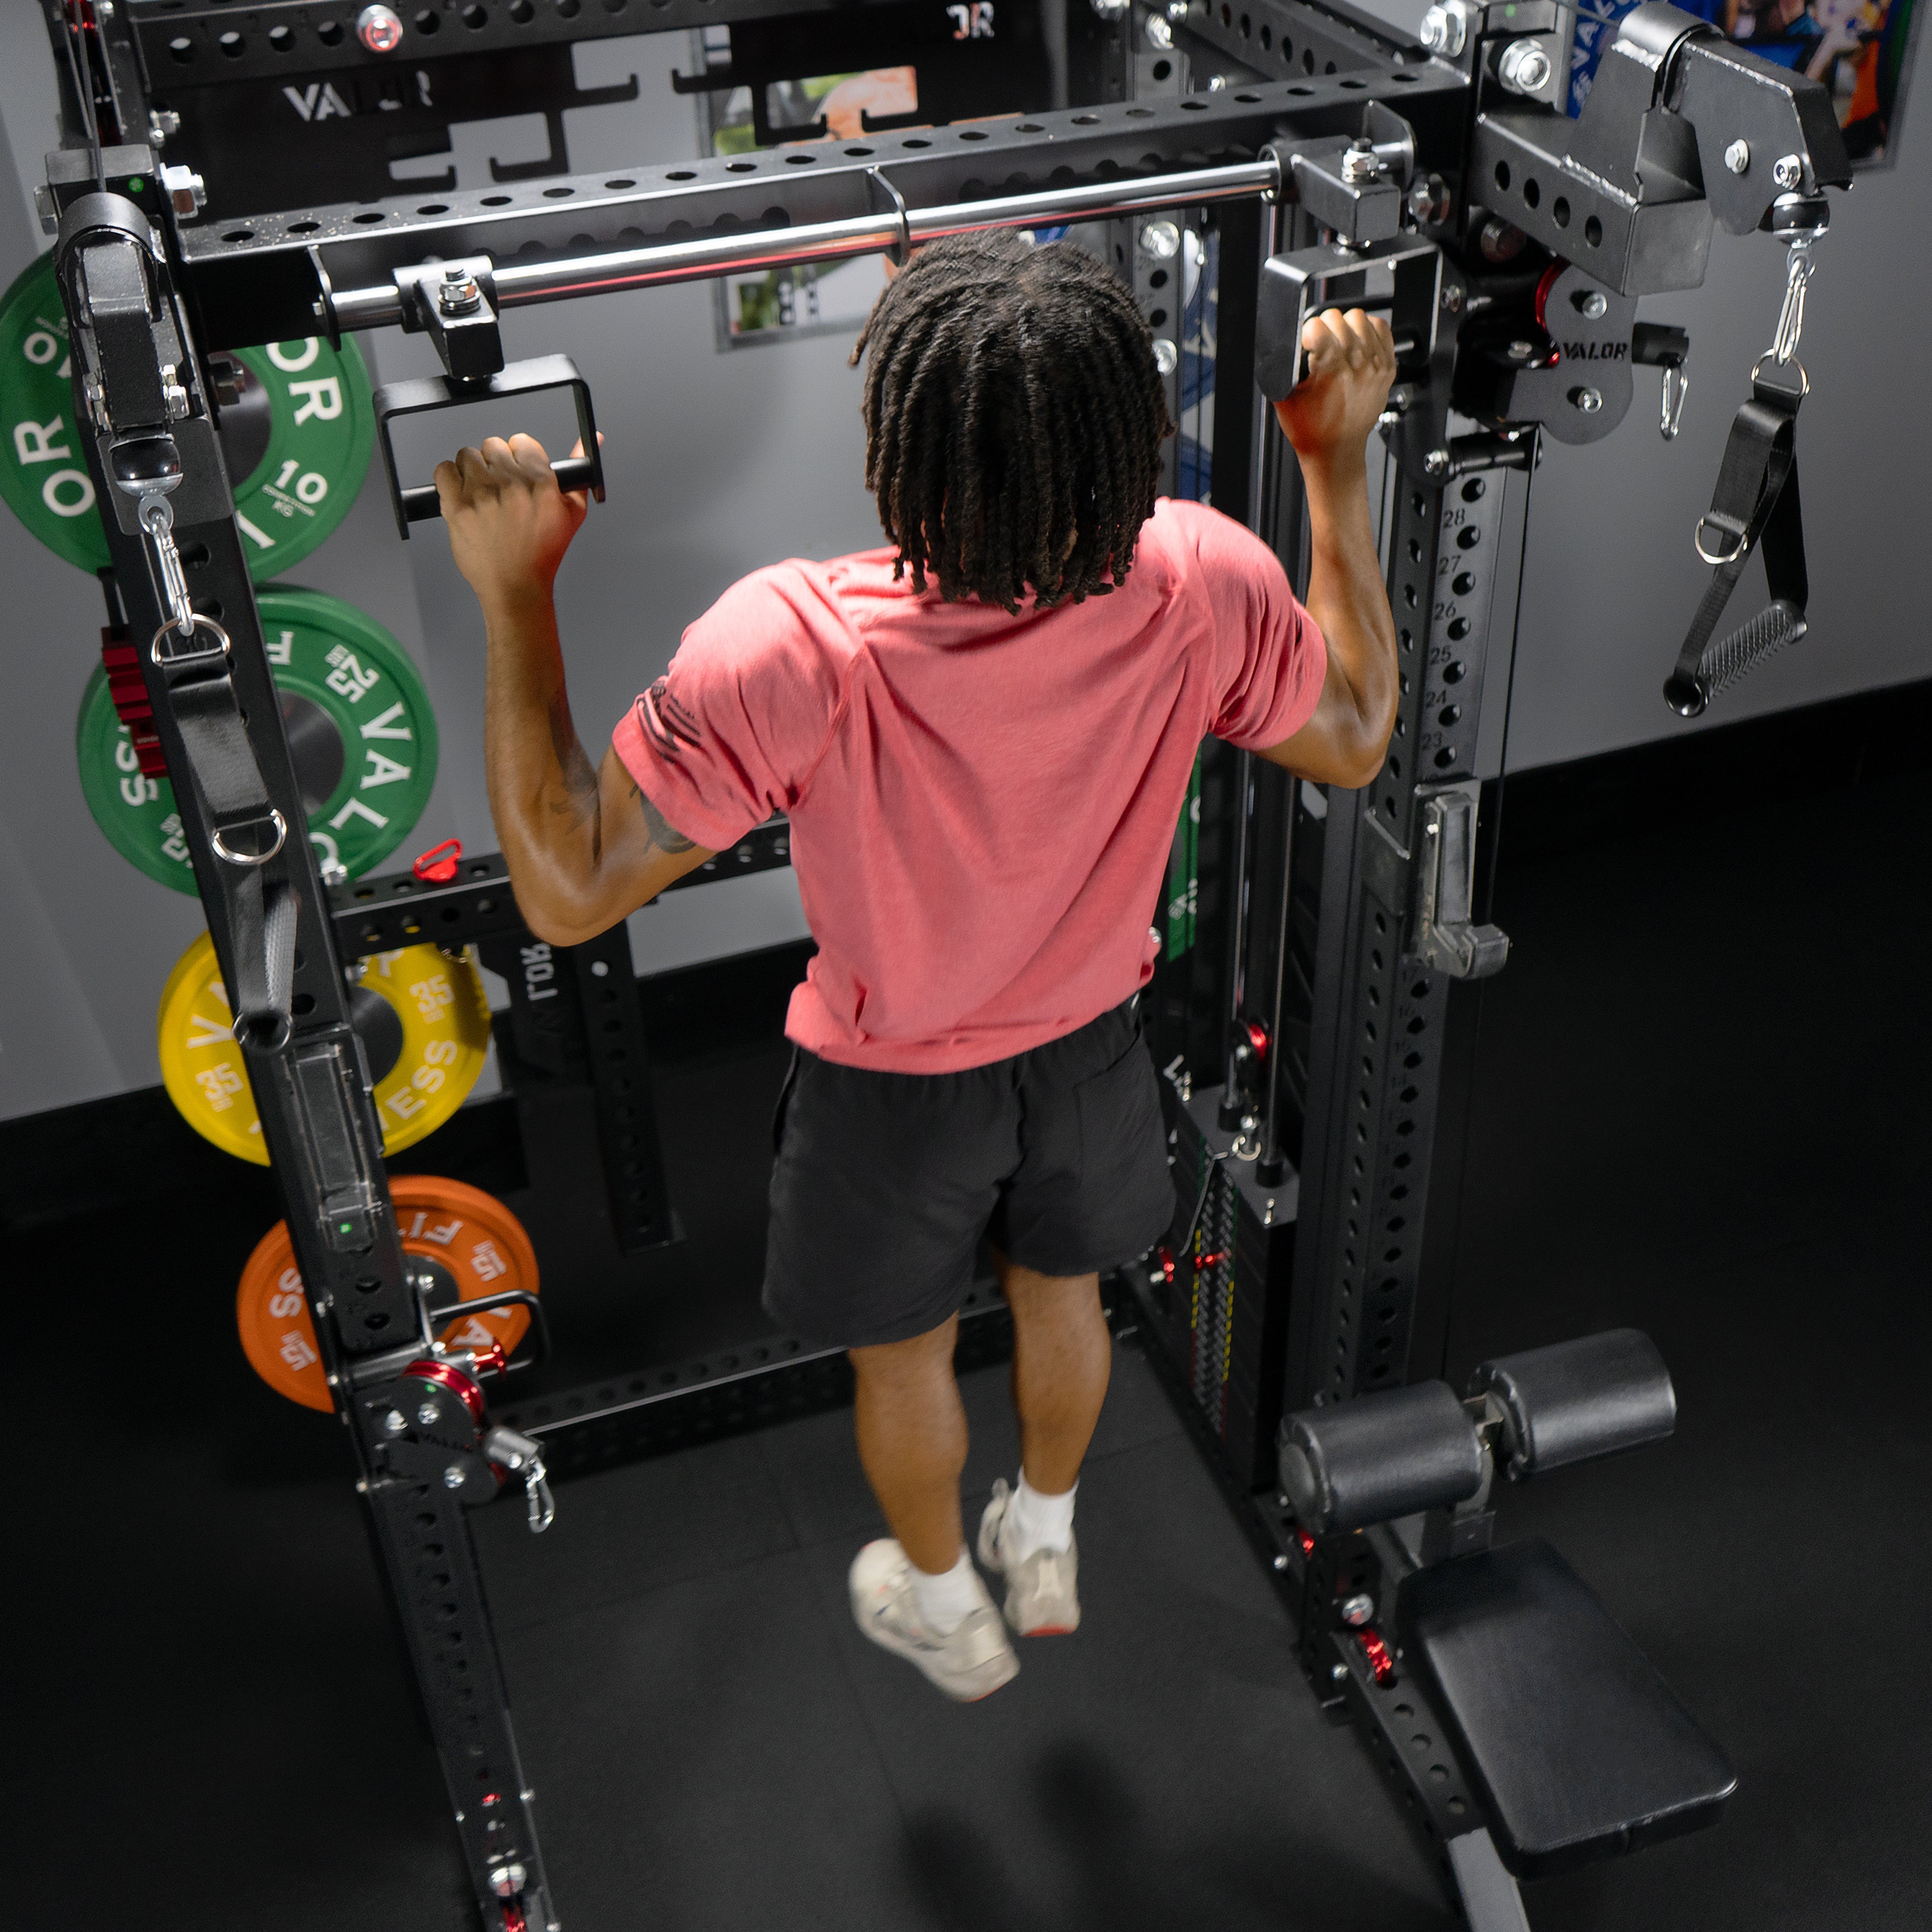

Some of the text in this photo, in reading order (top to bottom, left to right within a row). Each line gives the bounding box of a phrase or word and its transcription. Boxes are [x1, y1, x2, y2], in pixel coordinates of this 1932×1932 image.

[1563, 341, 1628, 360] VALOR
[275, 459, 328, 505] 10
[1443, 507, 1466, 529] 28
[1439, 554, 1462, 576] 27
[1434, 599, 1457, 621] 26
[1430, 644, 1452, 665] 25
[325, 654, 380, 703] 25
[1425, 690, 1447, 708] 24
[1421, 730, 1442, 751] 23
[309, 701, 412, 864] VAL
[520, 942, 559, 1001] LOR
[410, 974, 454, 1014] 35
[195, 1061, 244, 1103] 35
